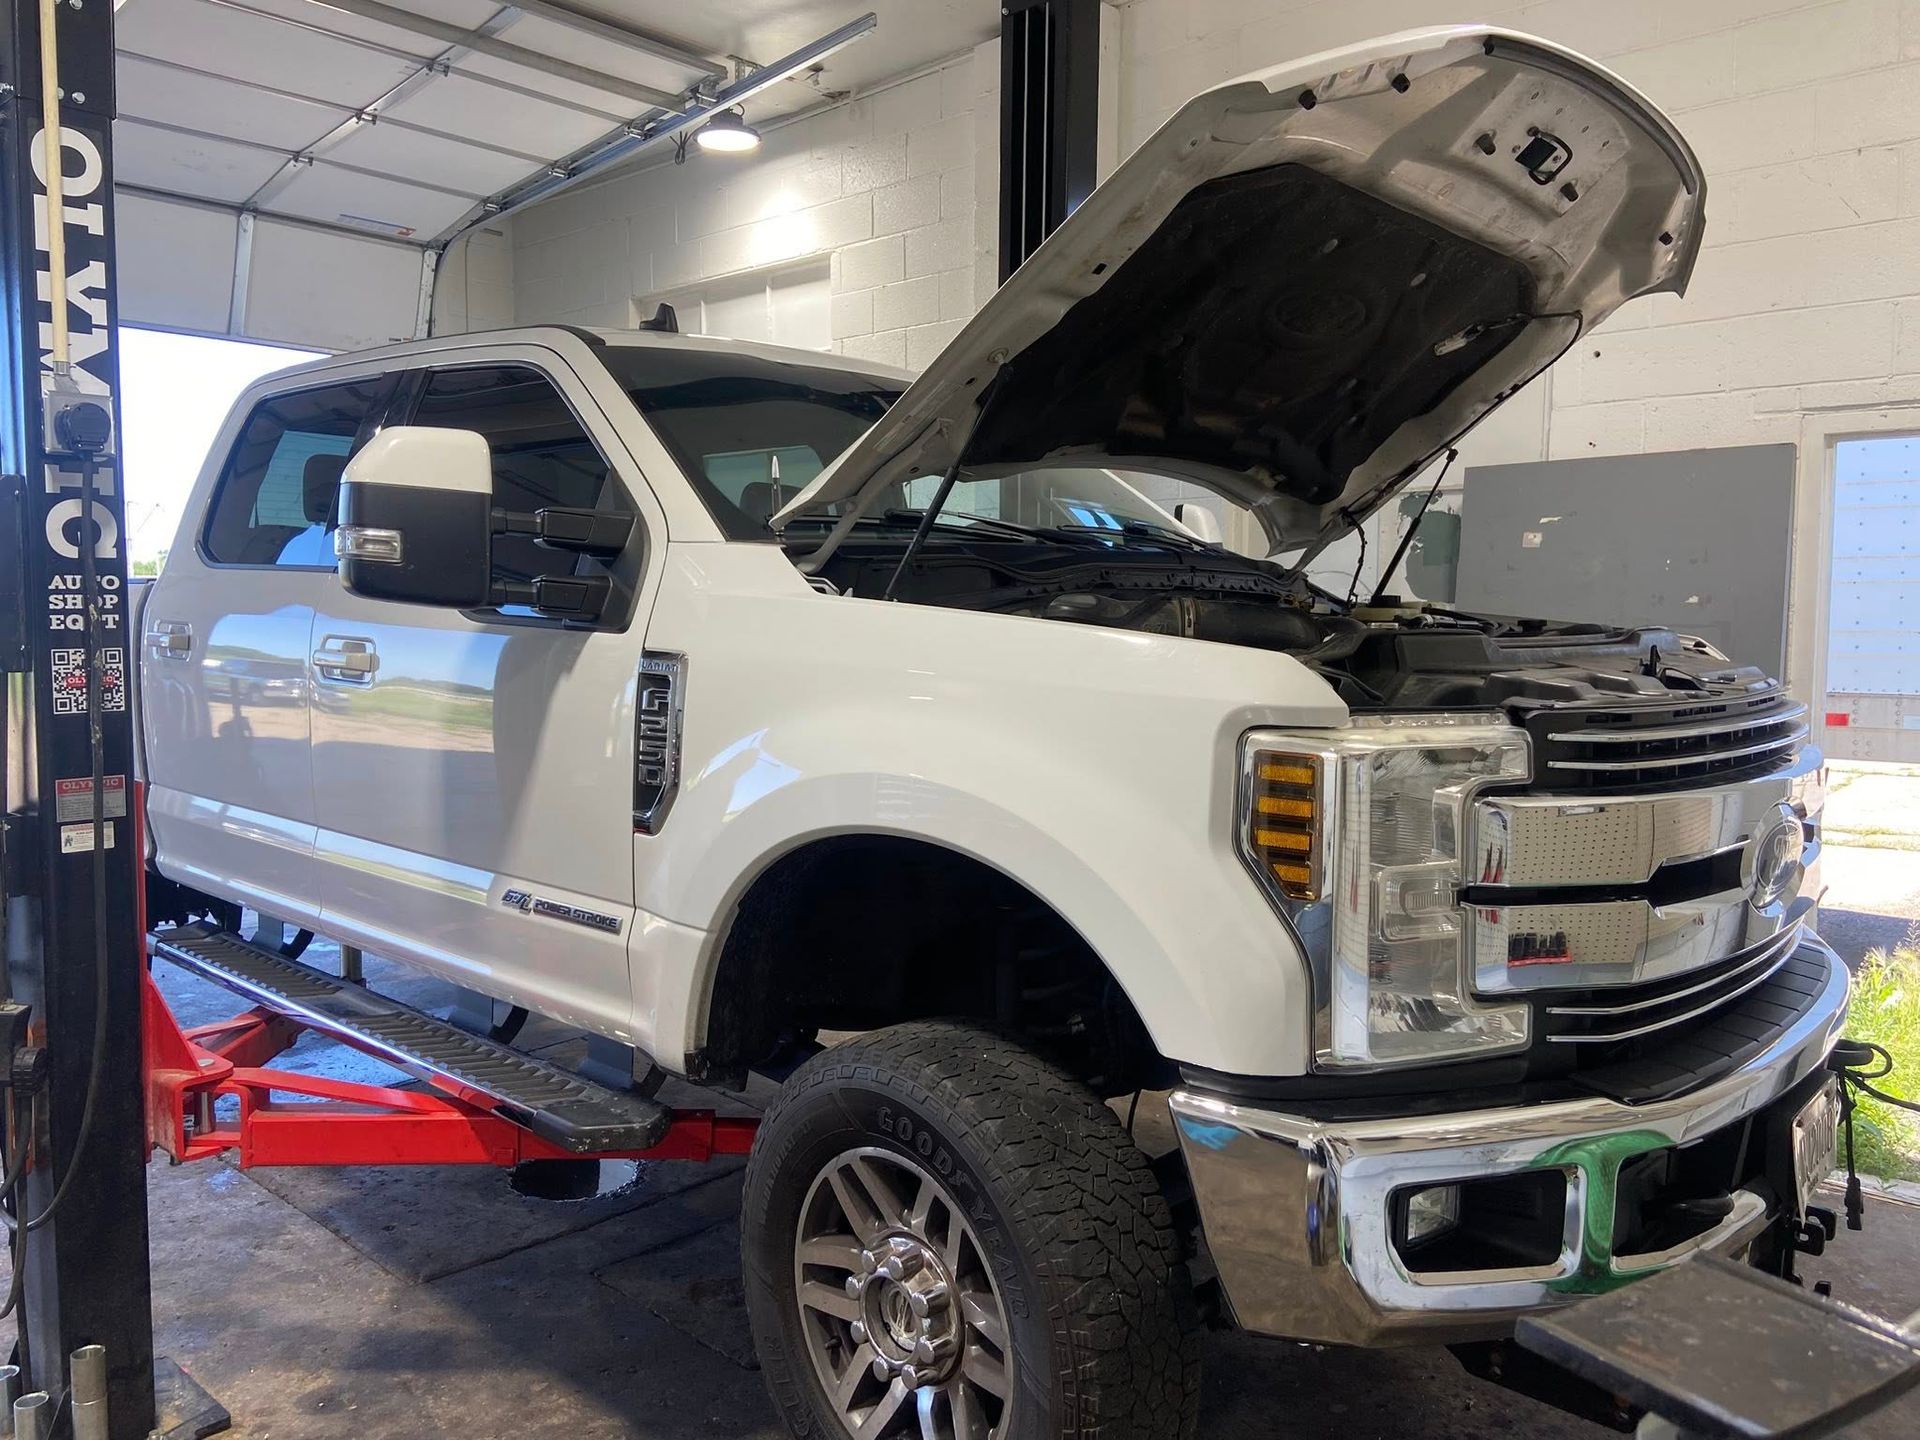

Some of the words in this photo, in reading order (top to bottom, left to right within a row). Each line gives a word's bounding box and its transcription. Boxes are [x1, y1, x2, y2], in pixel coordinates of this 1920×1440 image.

[31, 126, 118, 559] OLYMIC
[48, 575, 120, 590] AUO
[49, 595, 119, 610] SHP
[50, 614, 120, 631] EQT
[535, 899, 572, 916] POWER
[572, 909, 617, 928] STROKE
